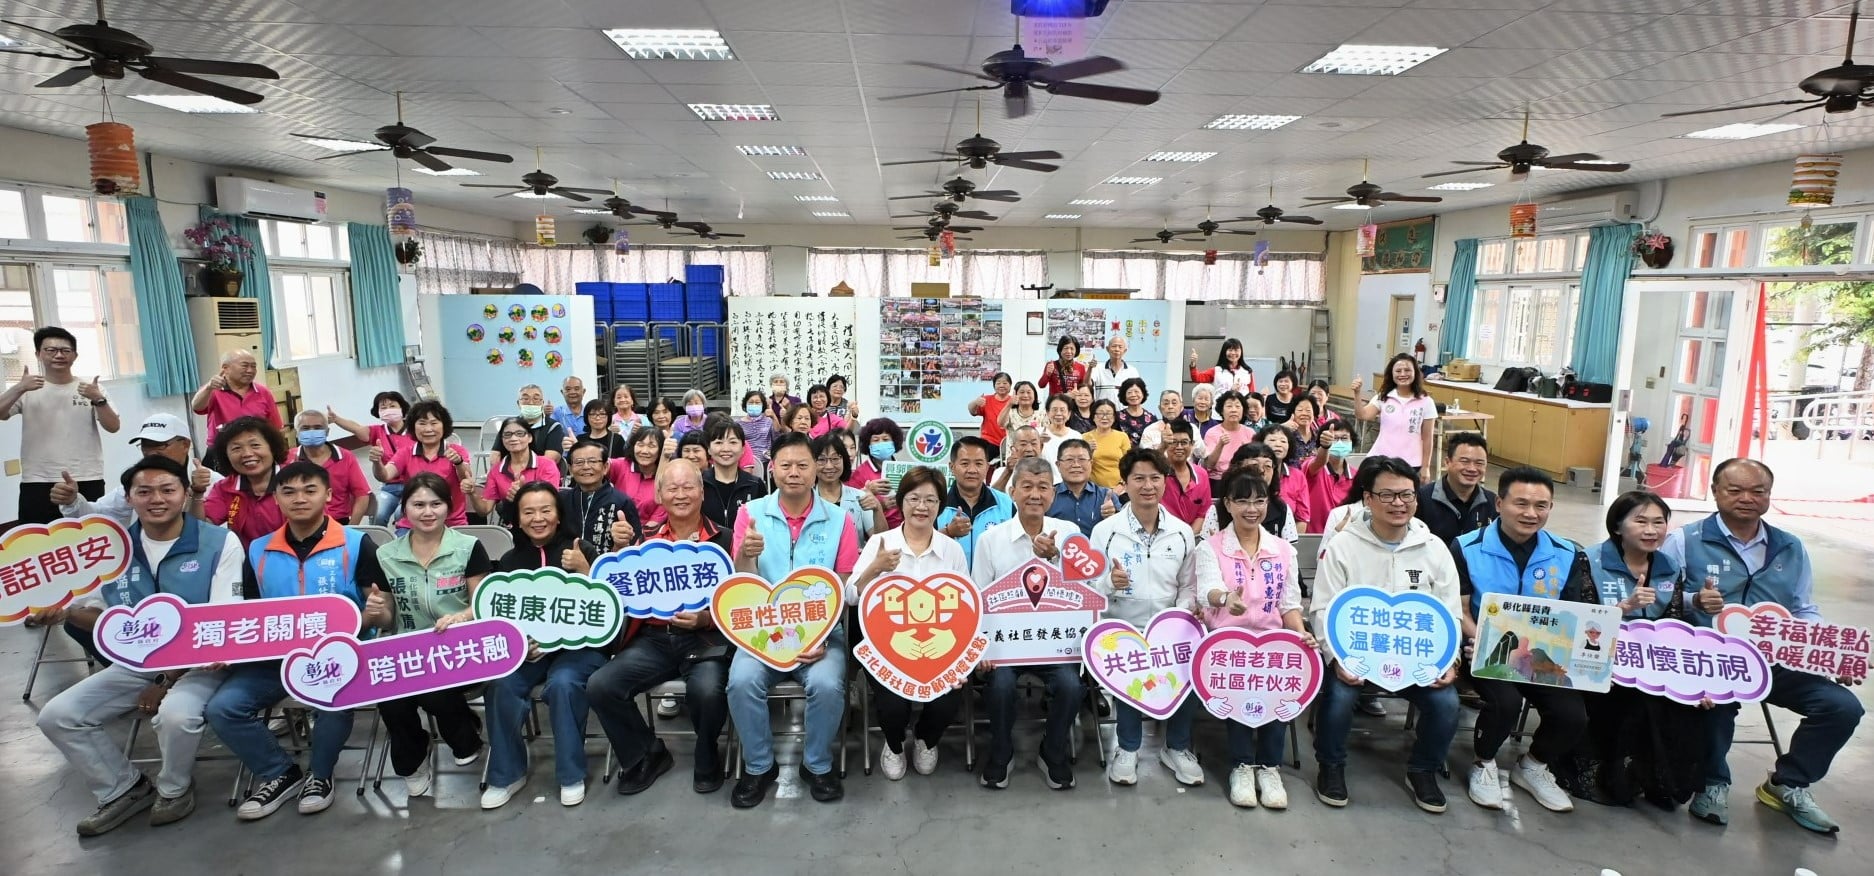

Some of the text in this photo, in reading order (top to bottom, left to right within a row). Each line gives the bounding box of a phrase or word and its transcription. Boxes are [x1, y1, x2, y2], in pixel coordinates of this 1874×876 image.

[0, 535, 116, 600] 話問安
[1062, 542, 1099, 576] 375
[606, 561, 720, 597] 餐飲服務
[489, 591, 606, 628] 健康促進
[730, 600, 828, 631] 靈性照顧
[1350, 605, 1435, 634] 在地安養
[1529, 615, 1559, 627] 幸福卡
[122, 616, 161, 639] 彰化
[192, 611, 328, 650] 獨老關懷
[1748, 614, 1872, 655] 幸福據點
[304, 657, 342, 679] 彰化
[367, 633, 511, 686] 跨世代共融
[1104, 641, 1193, 677] 共生社區
[1210, 650, 1303, 670] 疼惜老寶貝
[1612, 639, 1752, 684] 關懷訪視
[1209, 672, 1302, 692] 社區作伙來
